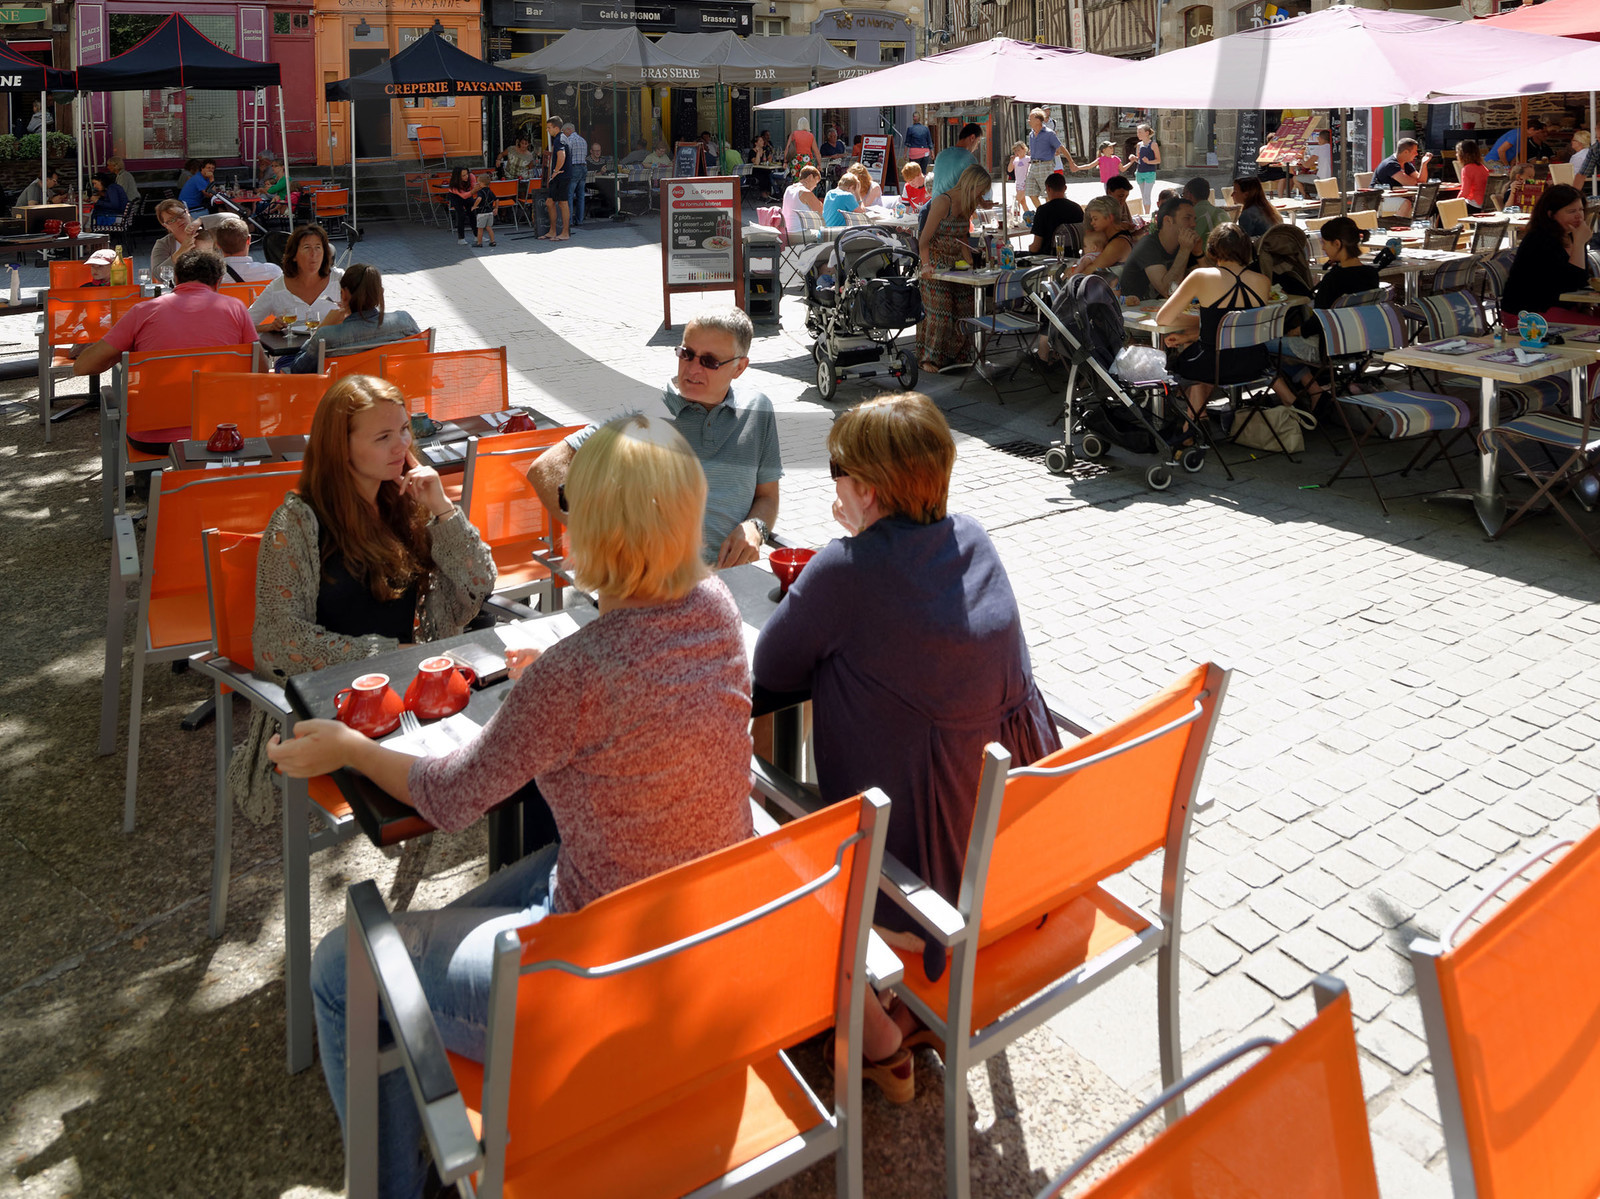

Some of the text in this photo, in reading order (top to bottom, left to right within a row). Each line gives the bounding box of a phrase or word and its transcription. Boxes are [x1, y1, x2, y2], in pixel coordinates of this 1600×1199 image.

[525, 7, 543, 16] Bar
[600, 9, 661, 21] Café le PIGNOM
[1253, 4, 1262, 17] le
[702, 14, 736, 25] Brasserie
[866, 17, 895, 30] Marine
[81, 26, 100, 37] GLACES
[755, 69, 776, 79] BAR
[385, 81, 522, 95] CREPERIE PAYSANNE
